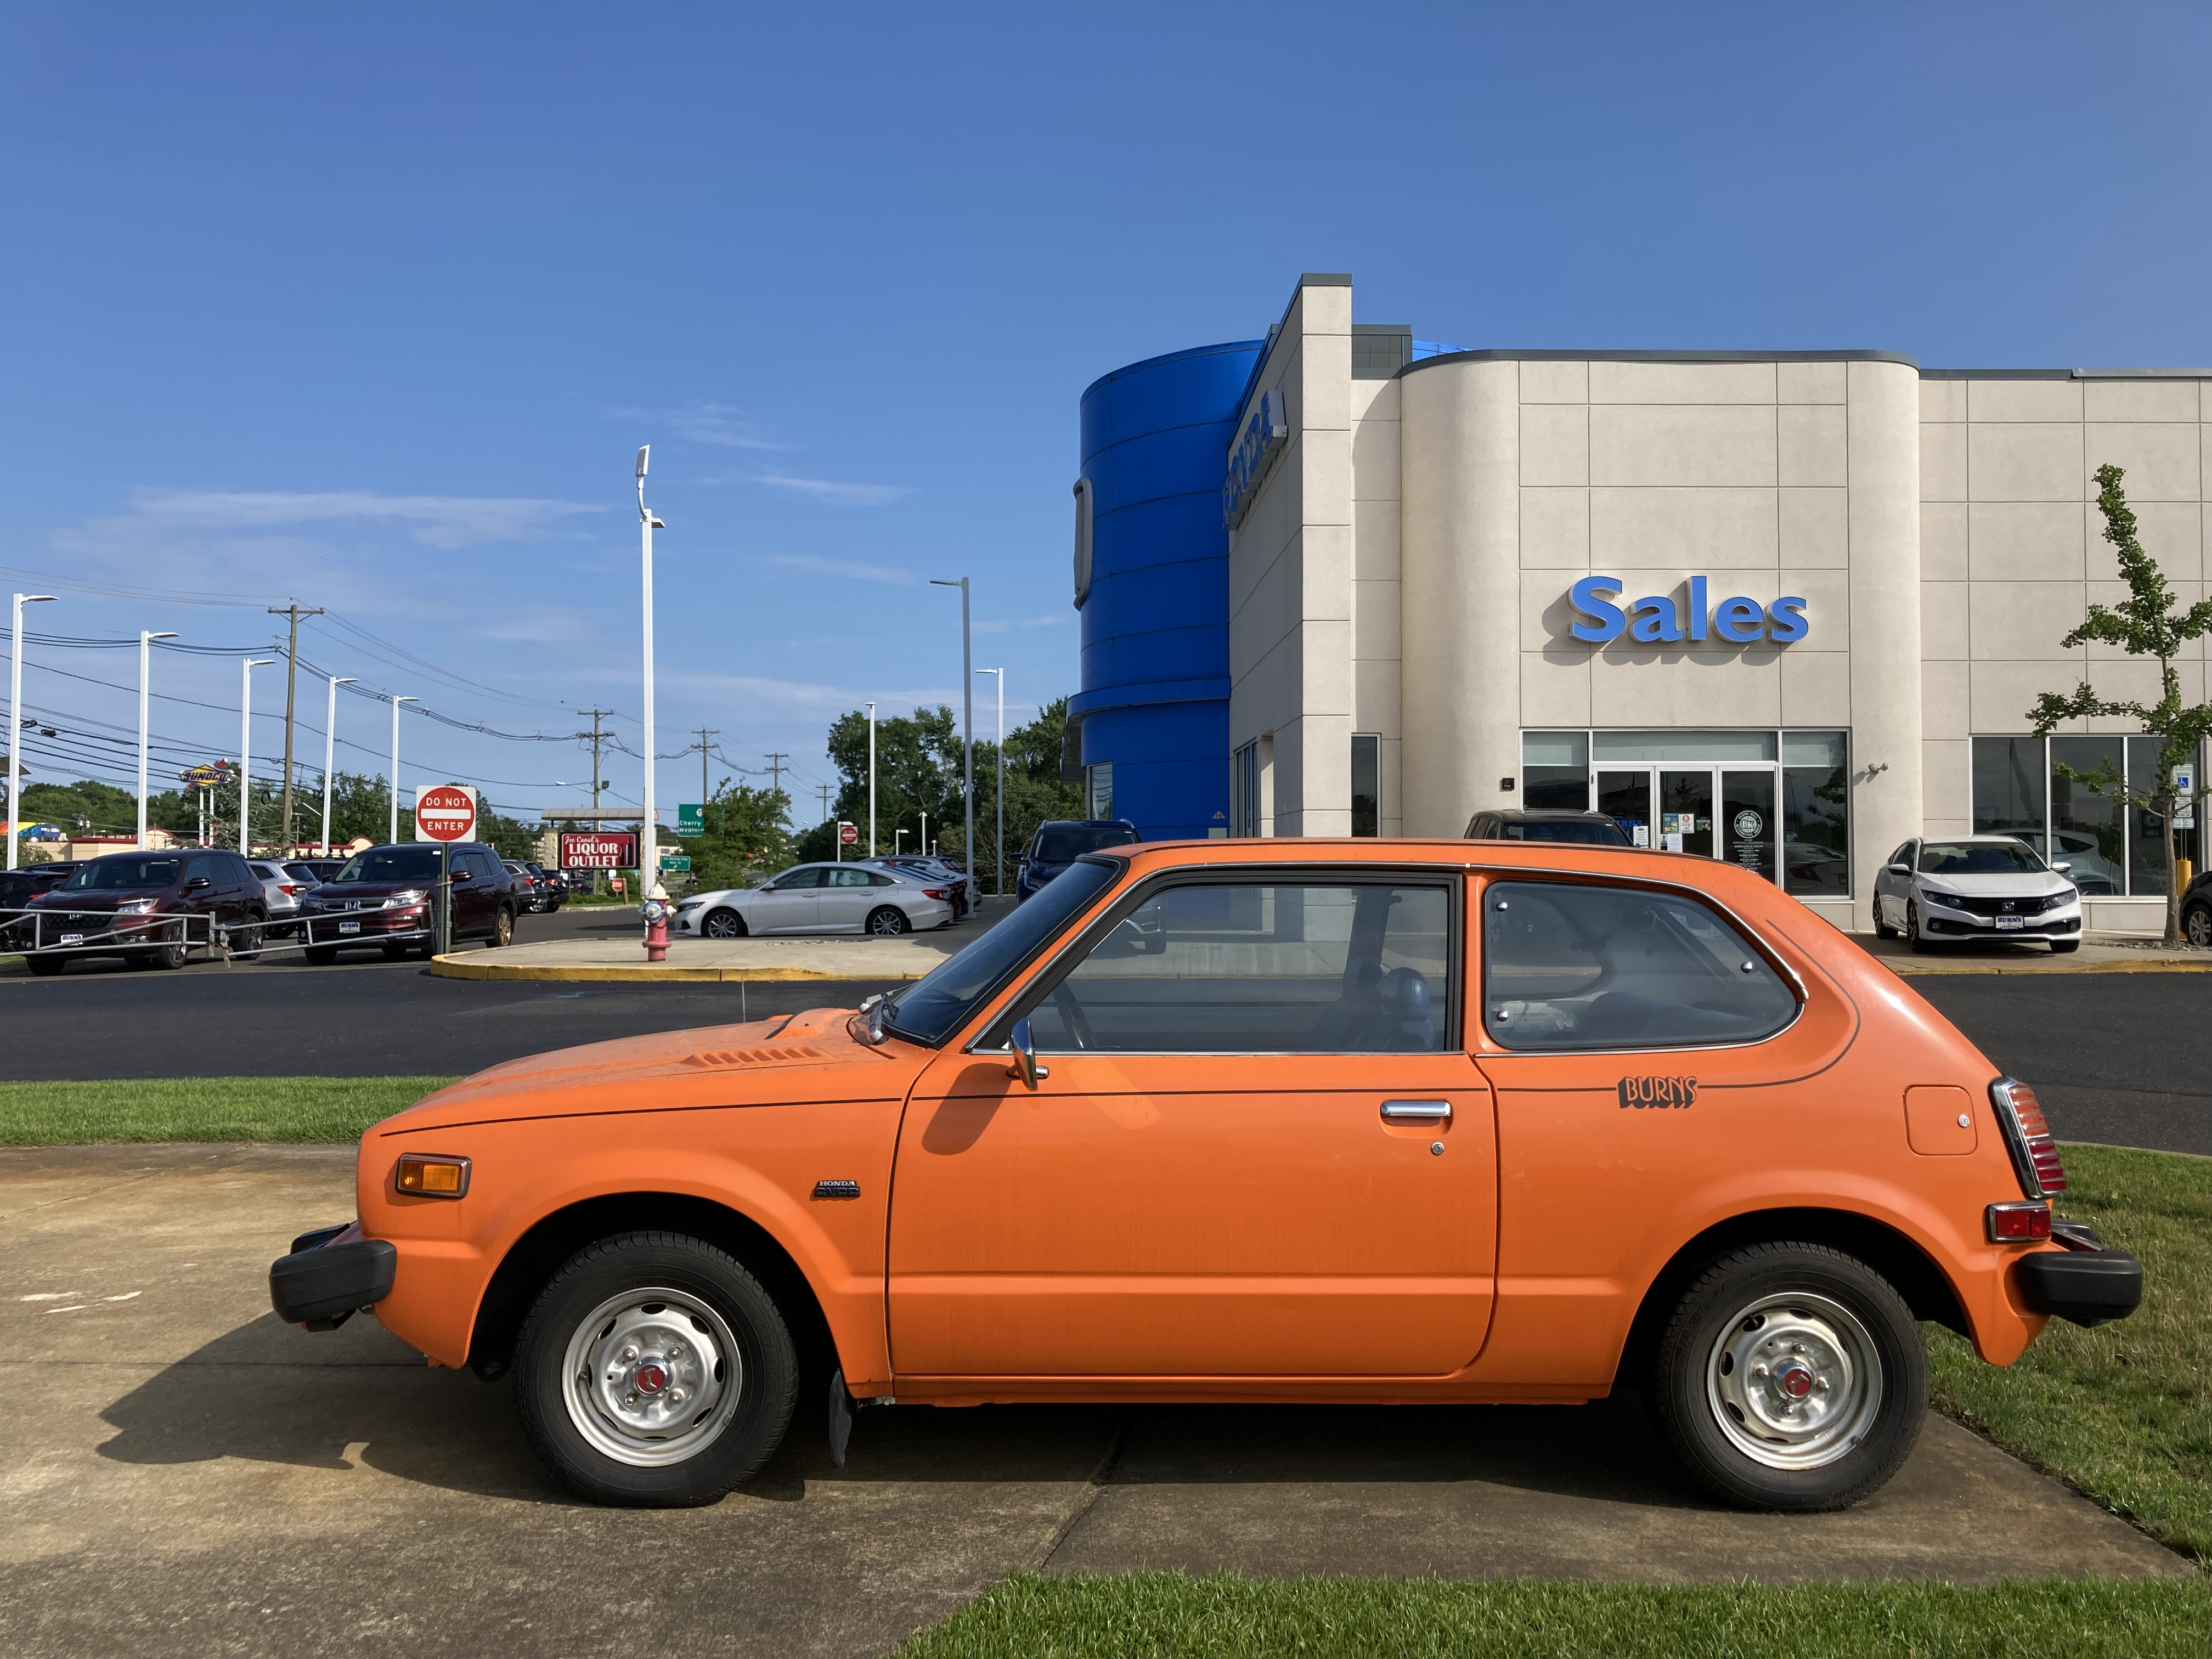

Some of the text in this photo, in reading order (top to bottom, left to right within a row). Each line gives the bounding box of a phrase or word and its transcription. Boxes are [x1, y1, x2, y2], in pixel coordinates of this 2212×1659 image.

[1568, 575, 1809, 642] Sales
[426, 797, 467, 807] DO NOT
[427, 821, 464, 831] ENTER
[1741, 820, 1754, 828] BK
[565, 836, 575, 844] Joe
[569, 843, 618, 856] LIQUOR
[569, 856, 618, 867] OUTLET
[1617, 1076, 1697, 1109] BURNS
